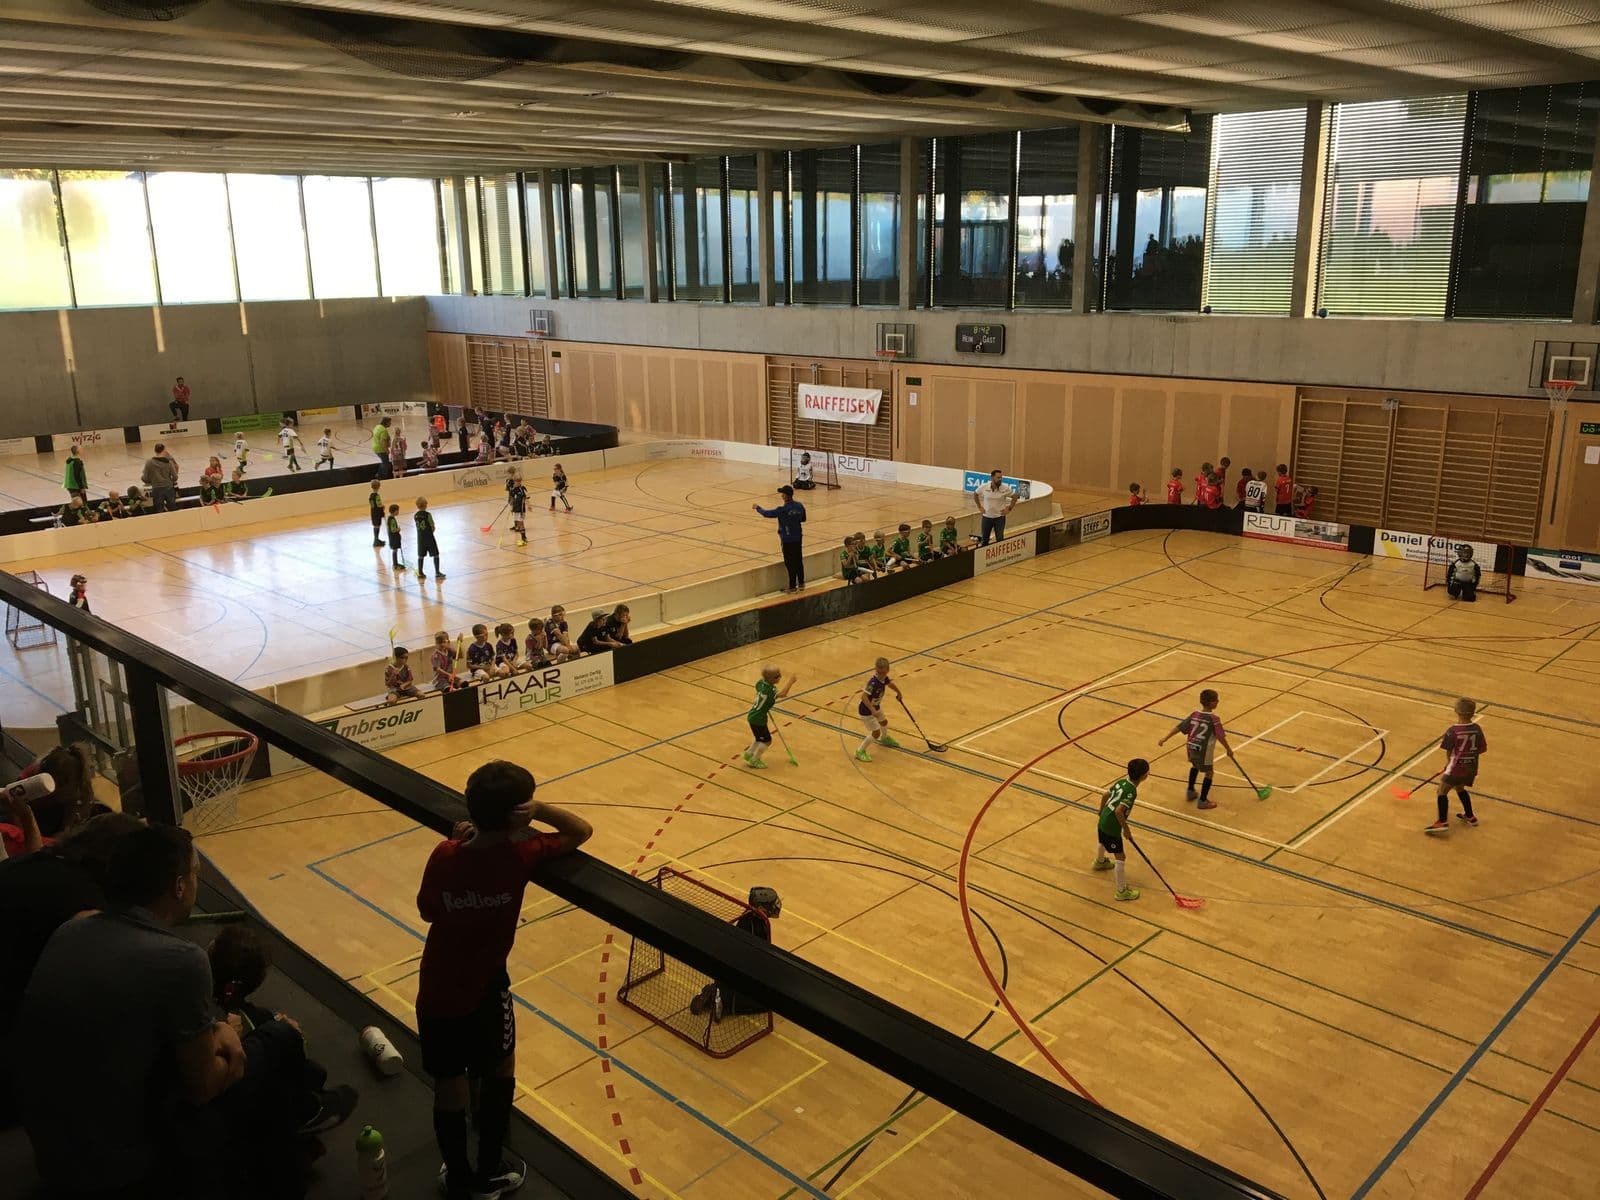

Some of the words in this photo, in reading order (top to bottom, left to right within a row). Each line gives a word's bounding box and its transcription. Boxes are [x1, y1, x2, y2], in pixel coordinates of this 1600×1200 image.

[804, 393, 876, 414] RAIFFEISEN
[1247, 486, 1261, 498] 80
[985, 537, 1026, 560] RAIFFEISEN
[1380, 531, 1422, 546] Daniel
[483, 669, 561, 704] HAAR
[519, 687, 562, 708] PUR
[340, 708, 424, 738] mbrsolar
[1190, 720, 1209, 739] 72
[1456, 734, 1478, 752] 71
